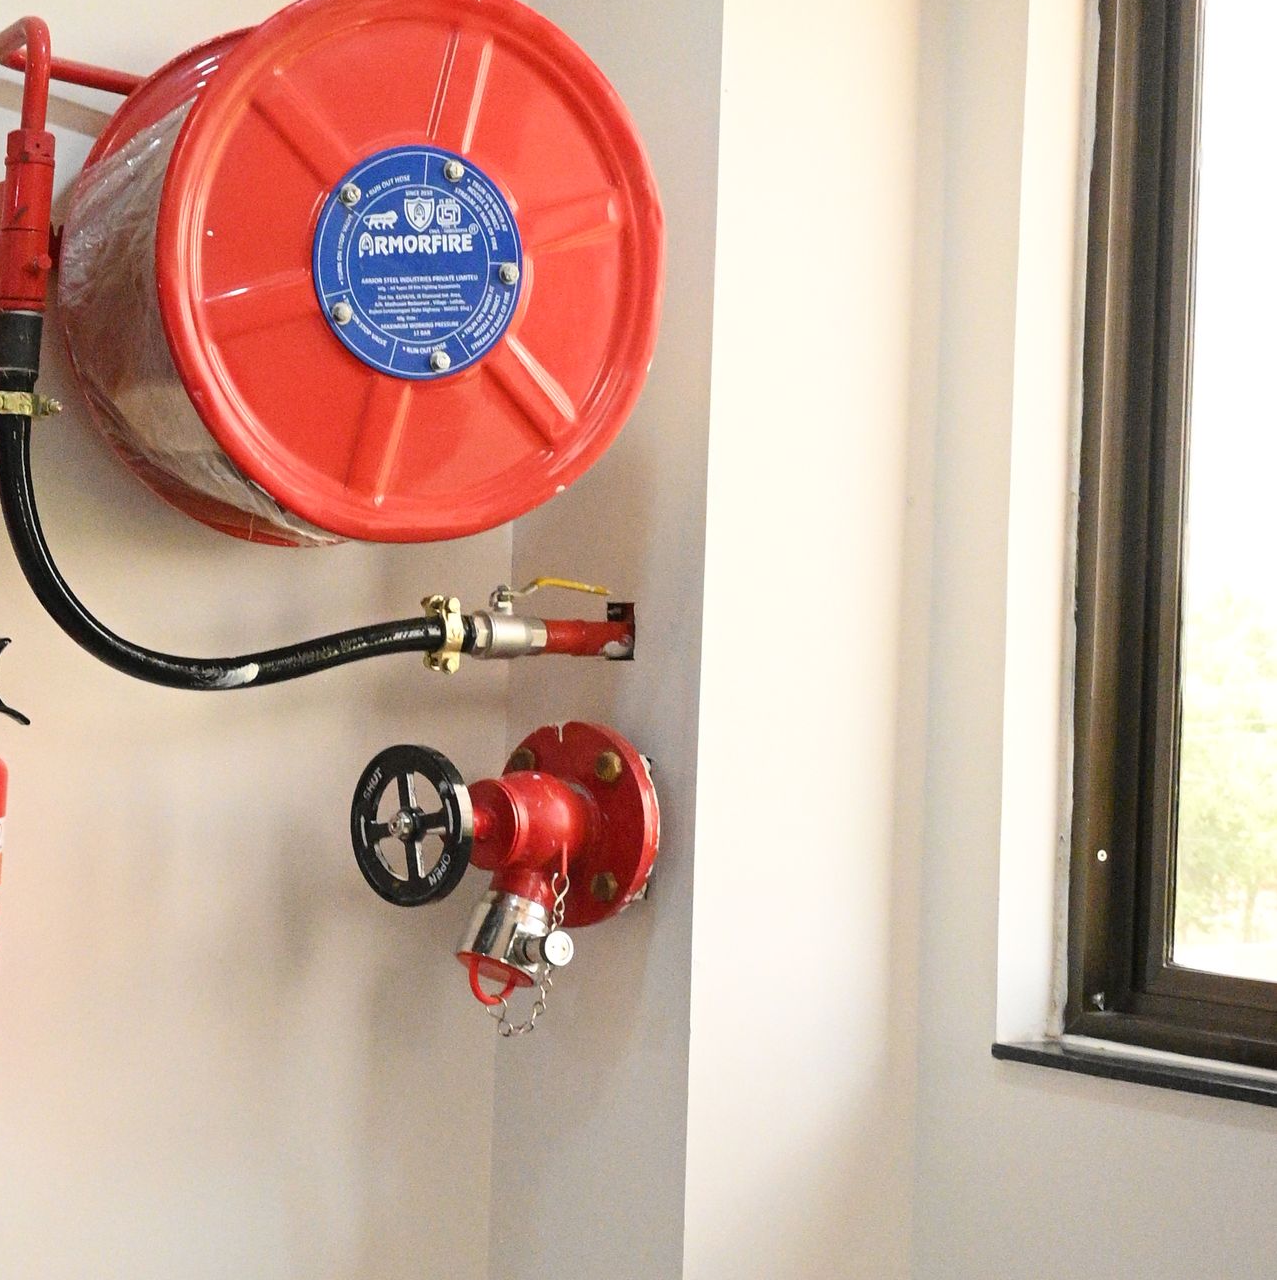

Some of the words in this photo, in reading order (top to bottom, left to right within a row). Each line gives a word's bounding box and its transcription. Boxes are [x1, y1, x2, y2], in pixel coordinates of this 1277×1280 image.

[382, 180, 394, 188] OUT
[358, 232, 473, 258] ARMORFIRE
[363, 767, 384, 801] SHUT
[428, 853, 451, 886] OPEN
